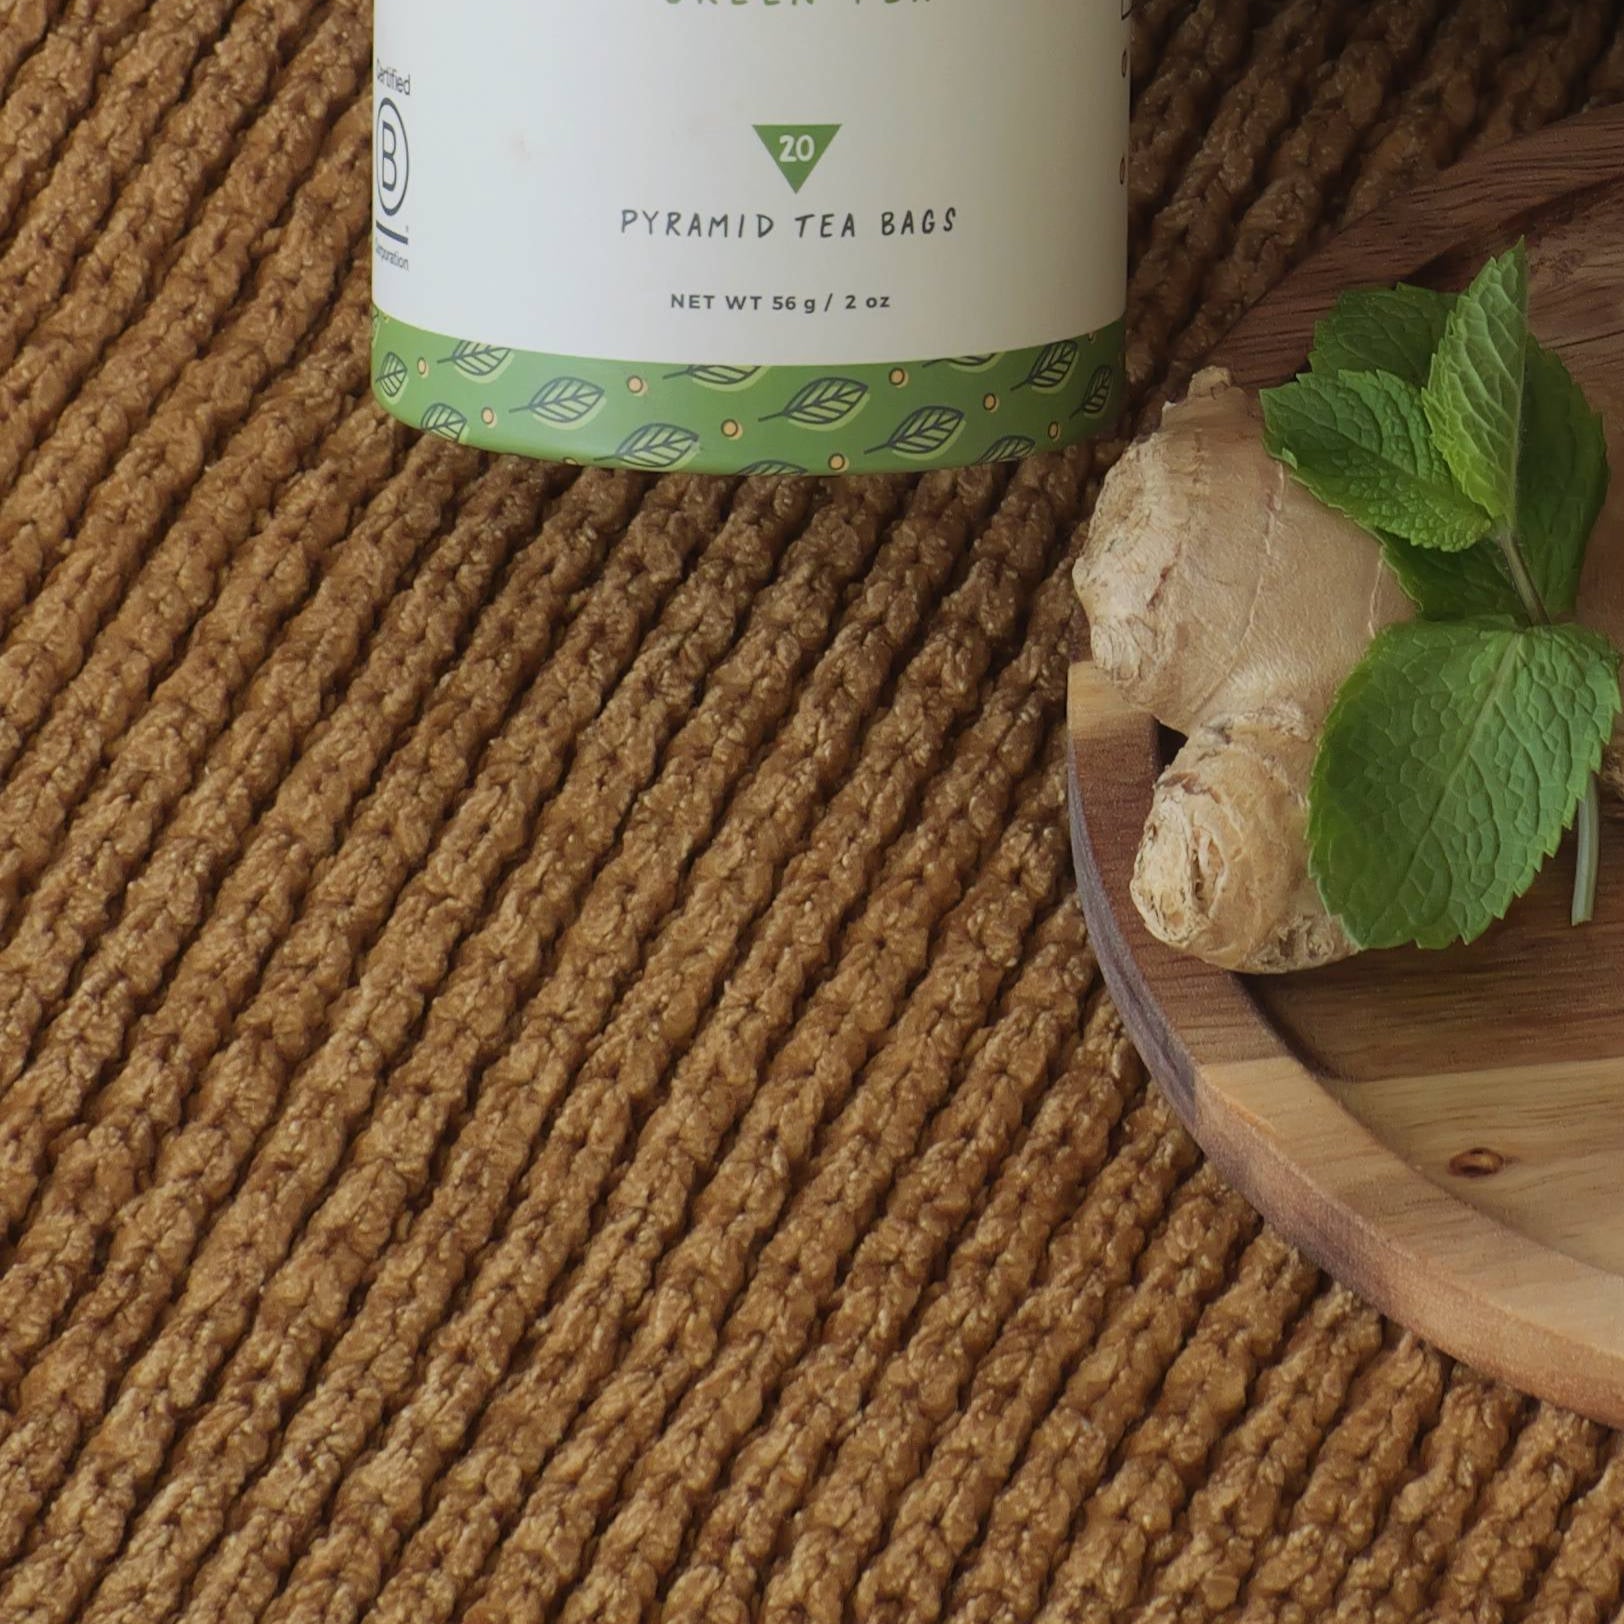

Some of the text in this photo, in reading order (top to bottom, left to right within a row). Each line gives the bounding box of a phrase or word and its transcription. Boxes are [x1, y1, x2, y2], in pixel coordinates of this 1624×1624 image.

[778, 134, 816, 163] 20
[620, 206, 957, 239] PYRAMID TEA BAGS
[670, 293, 716, 311] NET
[724, 294, 763, 311] WT
[771, 295, 797, 311] 56
[803, 298, 816, 315] g
[844, 294, 857, 310] 2
[865, 295, 891, 309] oz
